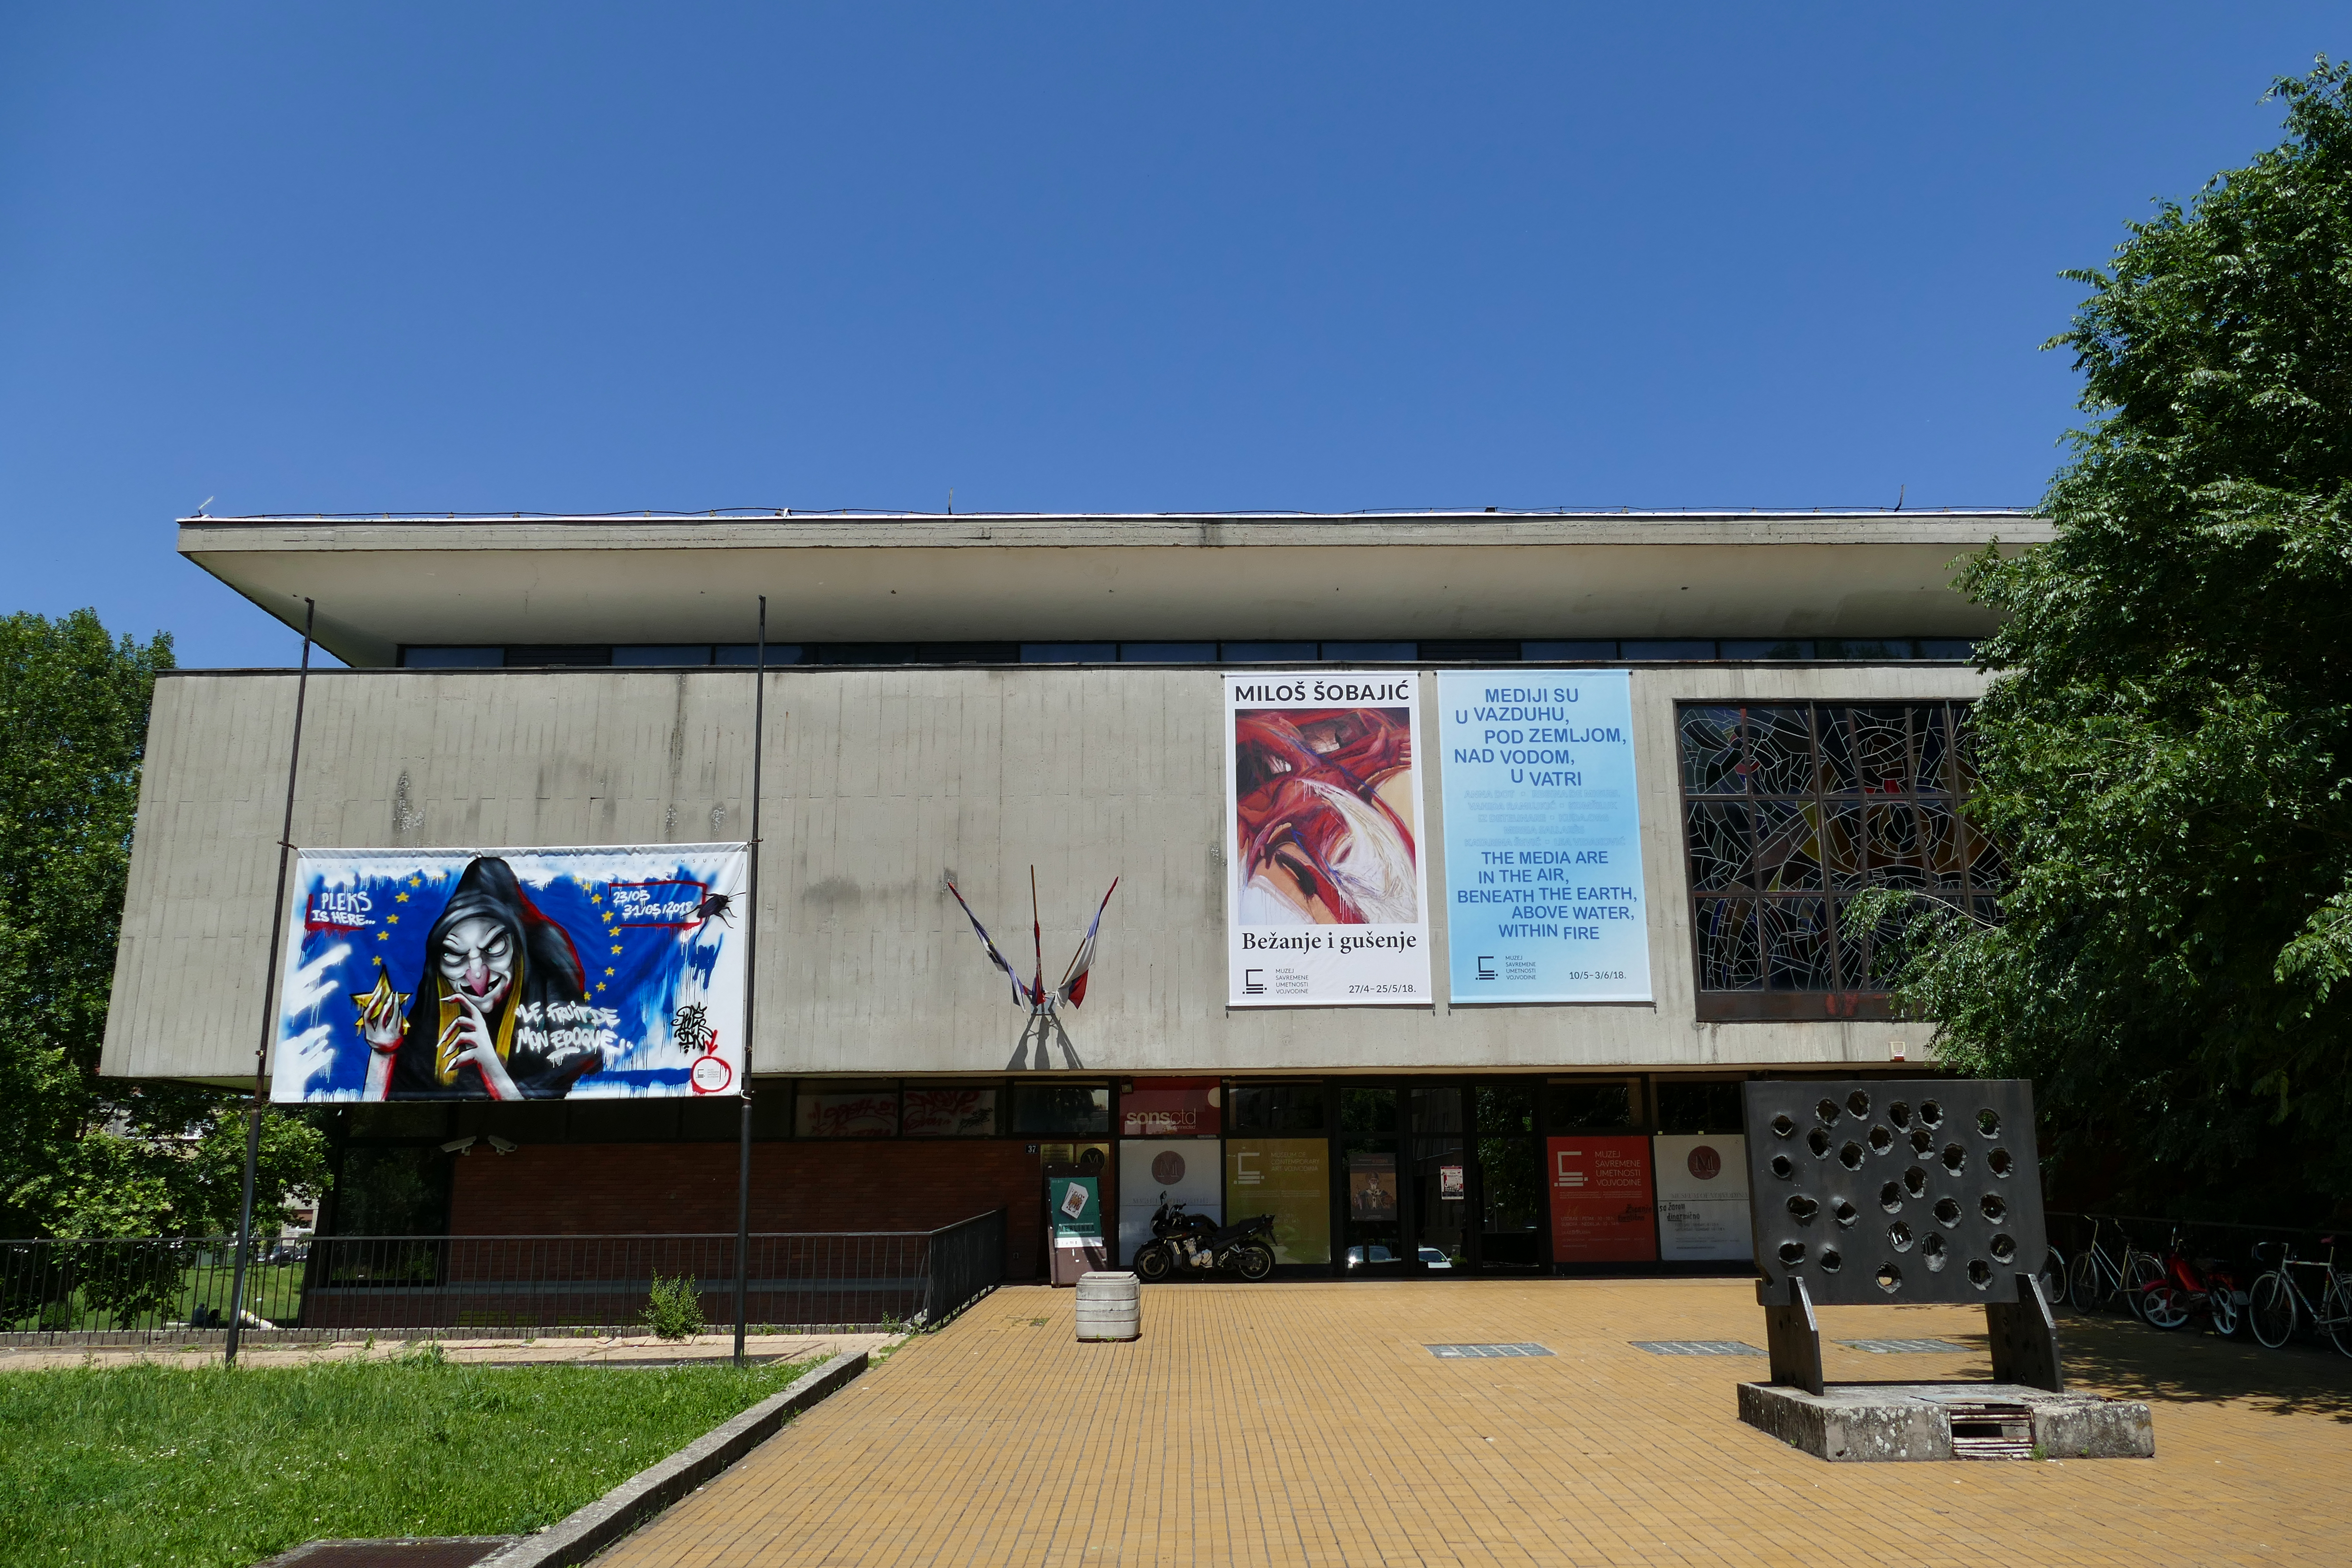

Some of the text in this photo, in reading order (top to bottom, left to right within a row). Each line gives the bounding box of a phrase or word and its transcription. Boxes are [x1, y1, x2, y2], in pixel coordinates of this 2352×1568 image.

[1235, 680, 1409, 702] MILOŠ ŠOBAJIĆ
[1485, 688, 1578, 703] MEDIJI SU
[1455, 707, 1569, 725] U VAZDUHU,
[1485, 728, 1626, 745] POD ZEMLJOM,
[1454, 749, 1574, 765] NAD VODOM,
[1511, 769, 1582, 786] U VATRI
[1464, 789, 1620, 798] ANNA DOT REGINA DE MIGUEL
[1468, 802, 1505, 810] VAHIDA
[1489, 814, 1546, 822] DETELINARE
[1559, 814, 1609, 822] KUDA.ORG
[1504, 826, 1537, 834] MIREIA
[1464, 836, 1625, 847] KATARINA ŠEVIĆ LEA VIDAKOVIĆ
[1481, 851, 1608, 864] THE MEDIA ARE
[1479, 868, 1569, 884] IN THE AIR,
[322, 891, 372, 913] PLEKS
[613, 890, 651, 903] 23/05
[1457, 887, 1637, 903] BENEATH THE EARTH,
[312, 909, 376, 926] IS HERE...
[1512, 906, 1634, 921] ABOVE WATER,
[1498, 924, 1600, 940] WITHIN FIRE
[1242, 931, 1417, 954] Bežanje i gušenje
[590, 1007, 621, 1025] DE
[515, 1026, 549, 1054] MON
[1126, 1108, 1196, 1125] sonsctd
[1028, 1145, 1036, 1153] 37
[1595, 1159, 1641, 1167] SAVREMENE
[1596, 1169, 1641, 1177] UMETNOSTI
[1596, 1178, 1642, 1186] VOJVODINE
[1668, 1202, 1686, 1211] žarom
